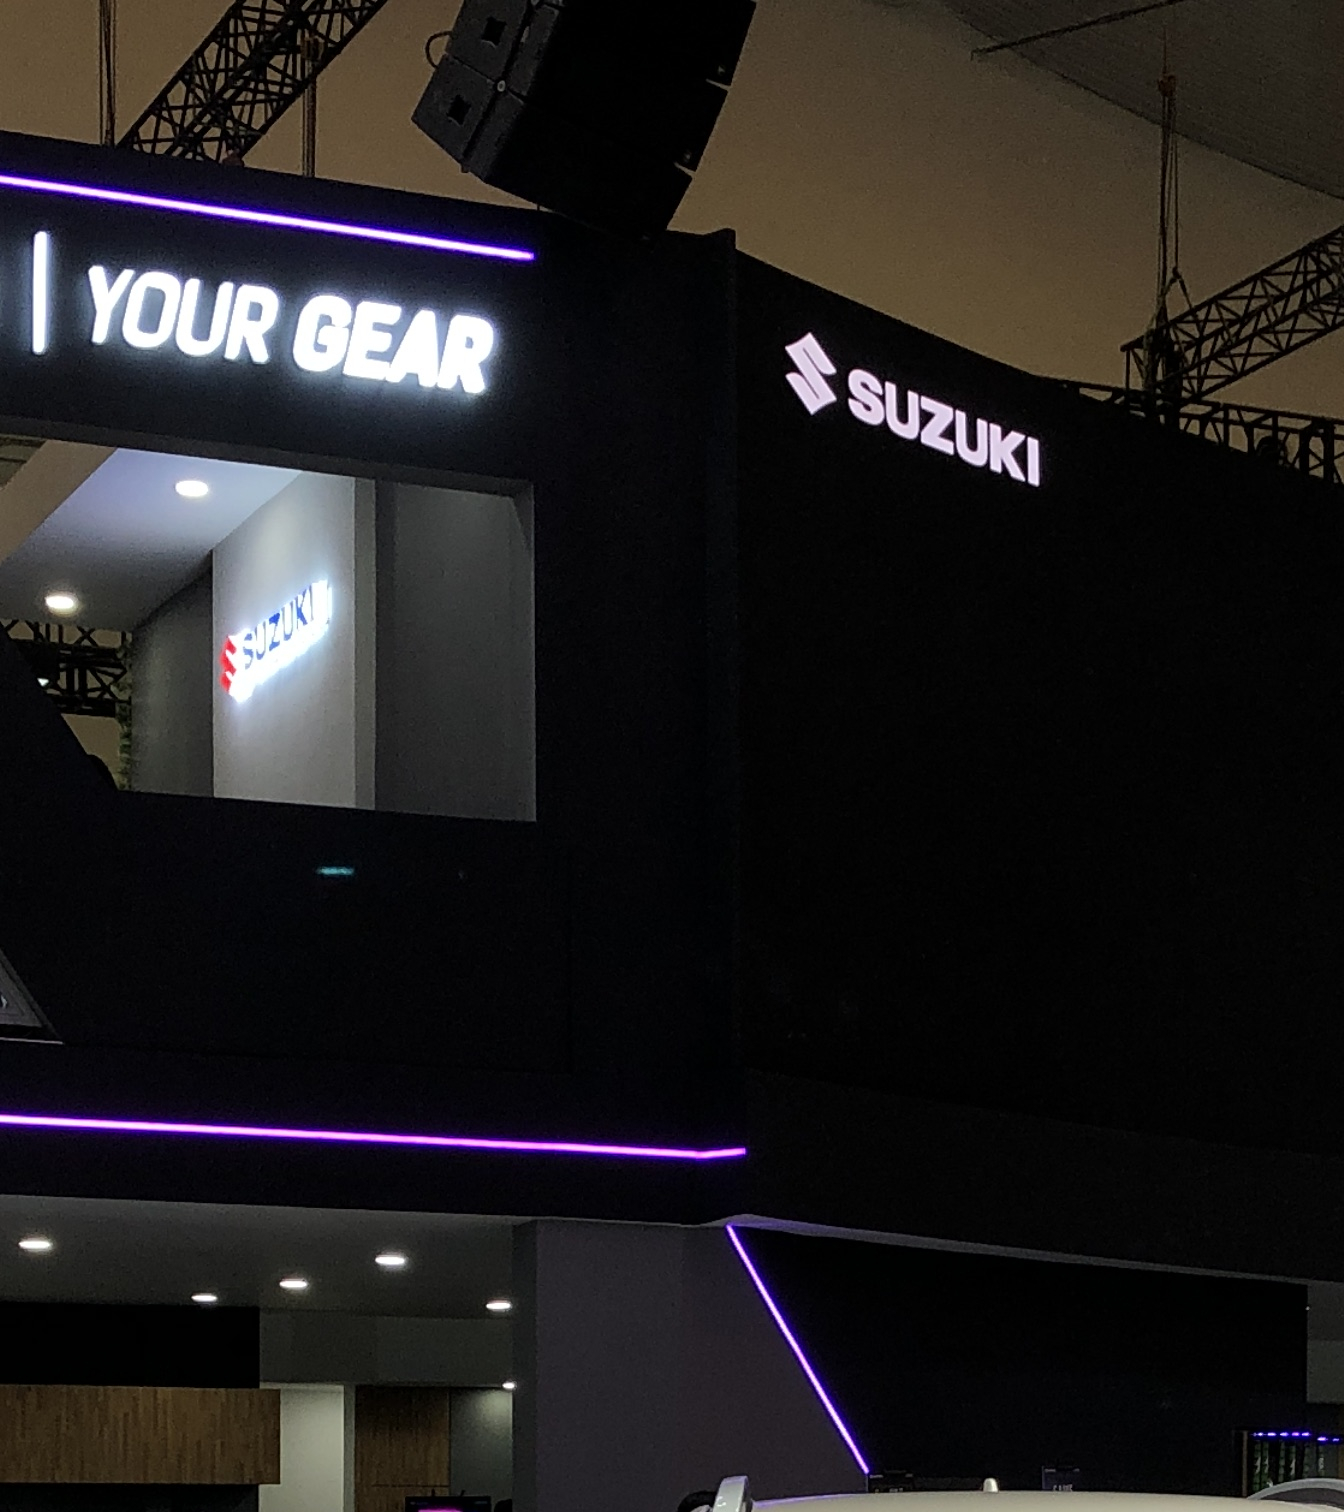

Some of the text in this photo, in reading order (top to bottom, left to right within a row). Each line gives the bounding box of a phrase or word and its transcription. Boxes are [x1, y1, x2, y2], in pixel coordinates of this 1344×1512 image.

[88, 265, 280, 364] YOUR
[292, 294, 495, 395] GEAR
[847, 368, 1040, 487] SUZUKI
[242, 583, 315, 671] SUZUKI
